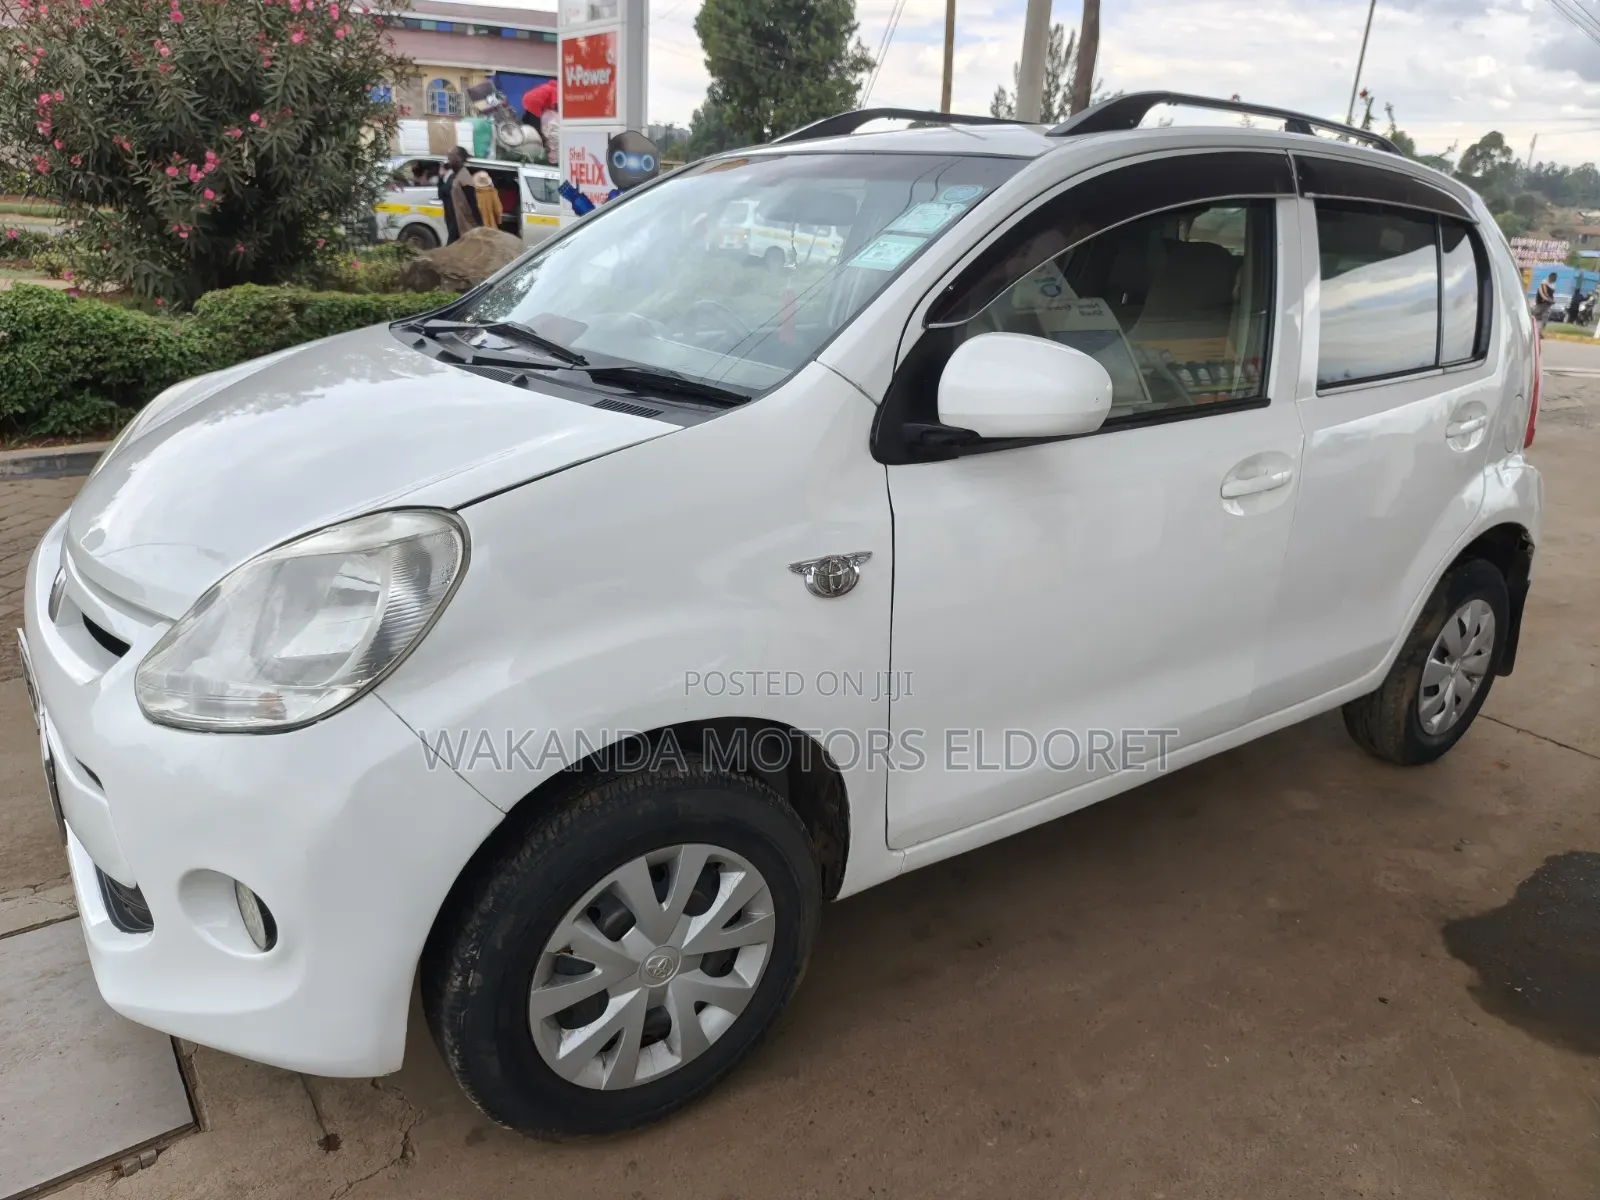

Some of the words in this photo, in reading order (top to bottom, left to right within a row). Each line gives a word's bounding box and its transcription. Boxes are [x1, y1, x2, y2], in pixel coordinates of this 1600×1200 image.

[565, 65, 611, 87] V-Power
[569, 146, 586, 160] Shell
[570, 163, 607, 185] HELIX
